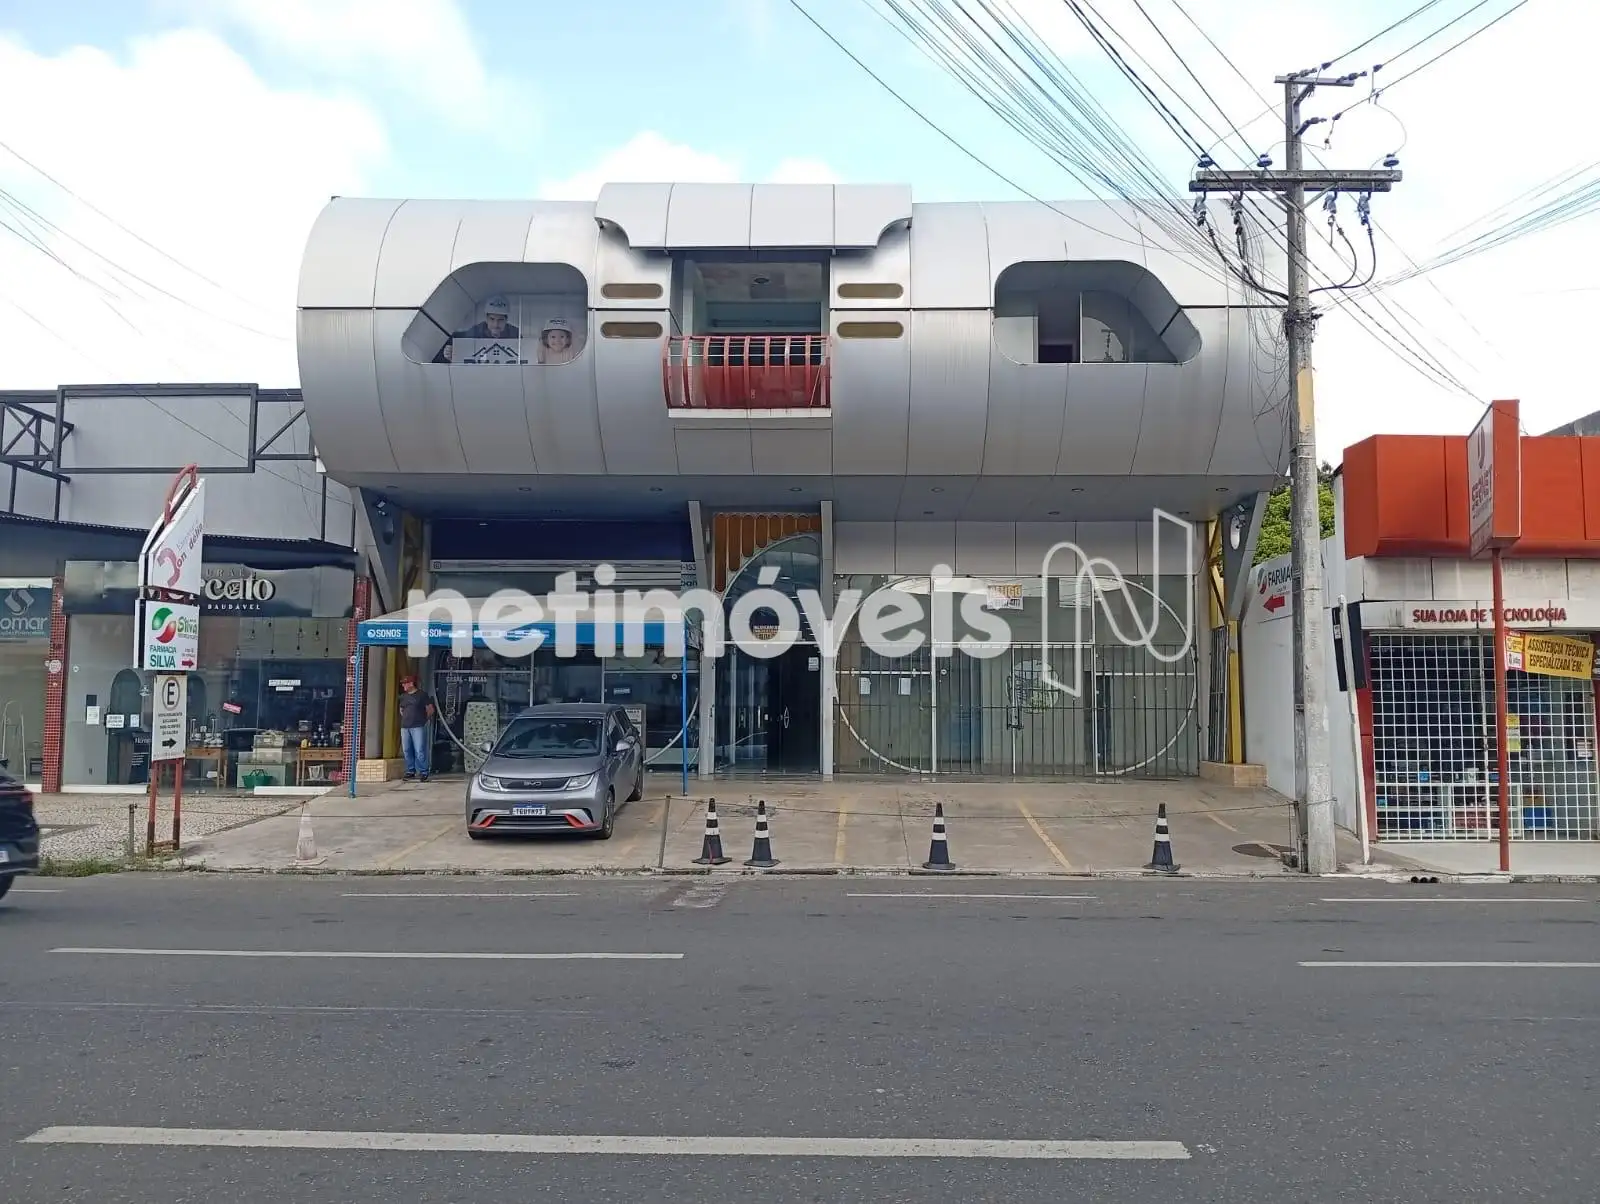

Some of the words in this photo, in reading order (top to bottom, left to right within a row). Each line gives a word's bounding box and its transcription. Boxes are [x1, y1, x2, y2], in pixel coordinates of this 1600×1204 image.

[138, 572, 274, 601] Mcato
[1413, 609, 1437, 623] SUA
[1439, 609, 1468, 623] LOJA
[1470, 608, 1487, 622] DE
[1489, 608, 1567, 622] TCNOLOGIA
[376, 629, 402, 638] SONOS
[150, 654, 176, 668] SILVA
[1529, 654, 1570, 671] ESPECIALIZADA
[167, 682, 175, 706] E
